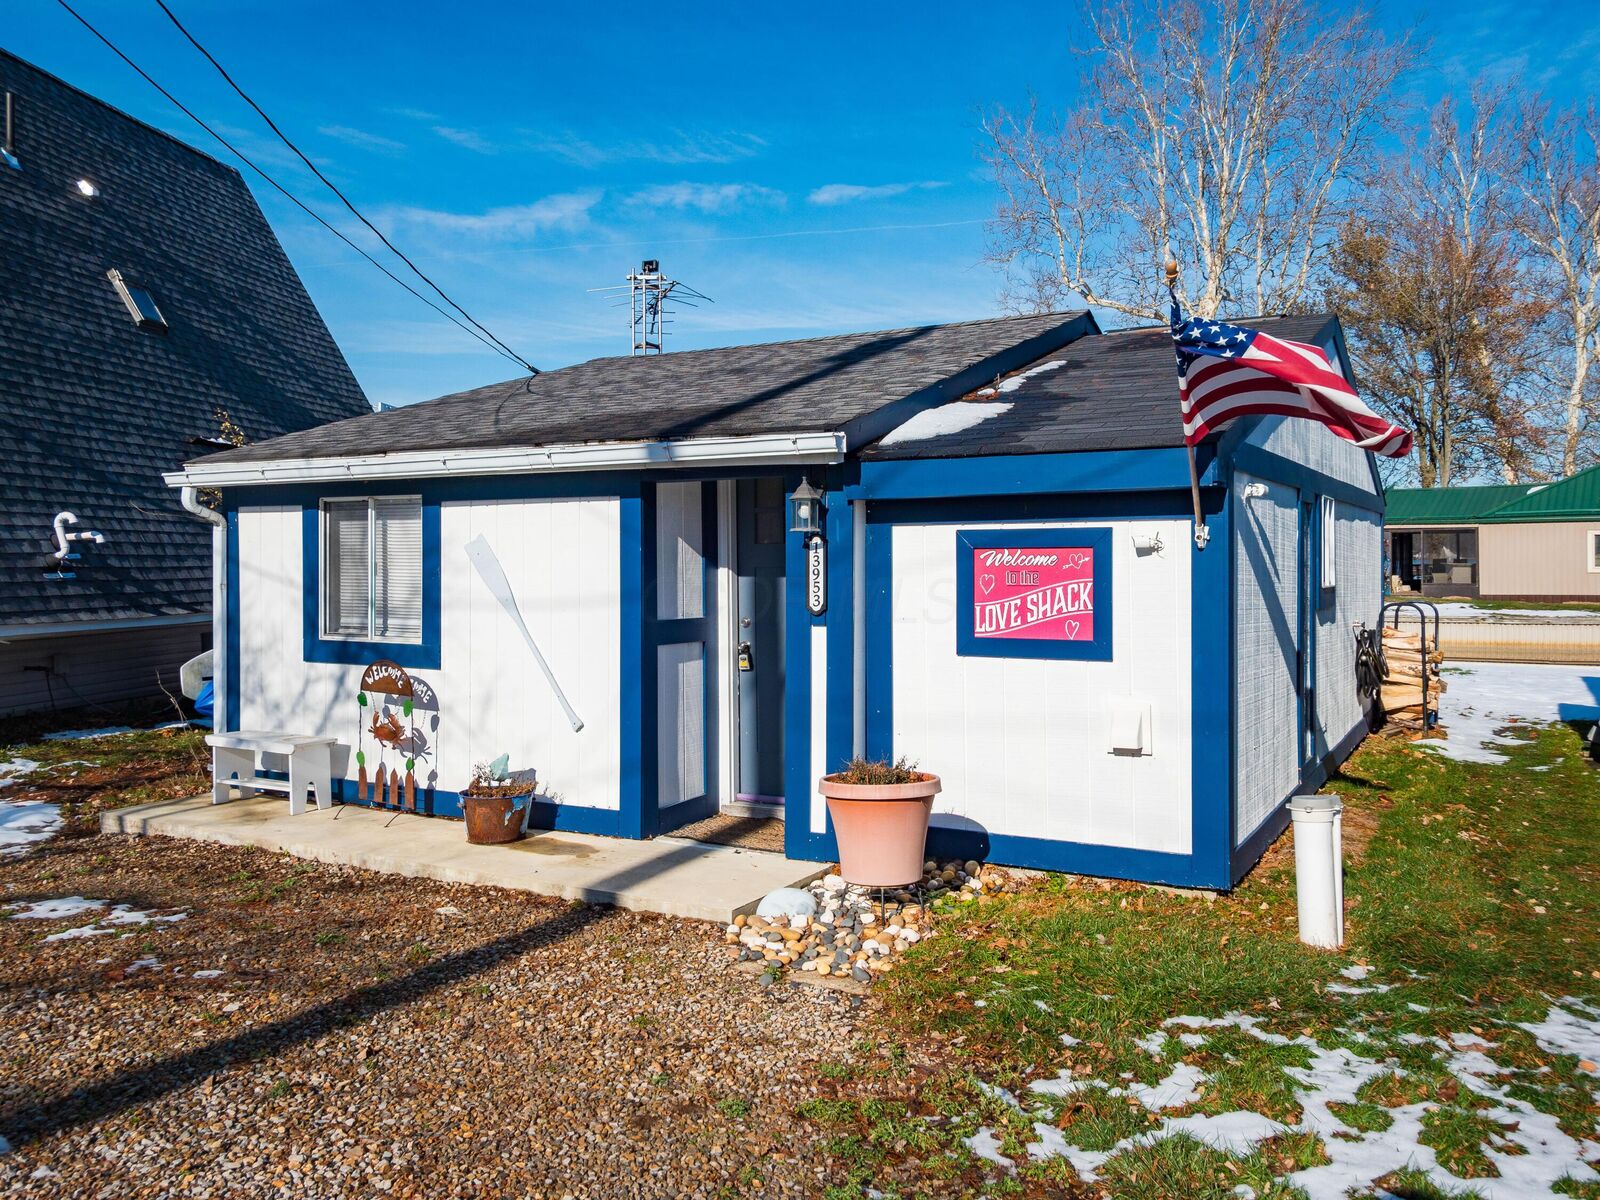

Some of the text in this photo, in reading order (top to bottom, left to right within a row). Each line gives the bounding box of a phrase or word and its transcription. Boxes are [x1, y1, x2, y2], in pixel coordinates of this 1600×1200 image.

[980, 549, 1058, 567] Welcome
[812, 542, 821, 607] 13953
[1006, 571, 1039, 586] to the
[975, 582, 1094, 633] LOVE SHACK
[365, 665, 404, 689] WELCOME
